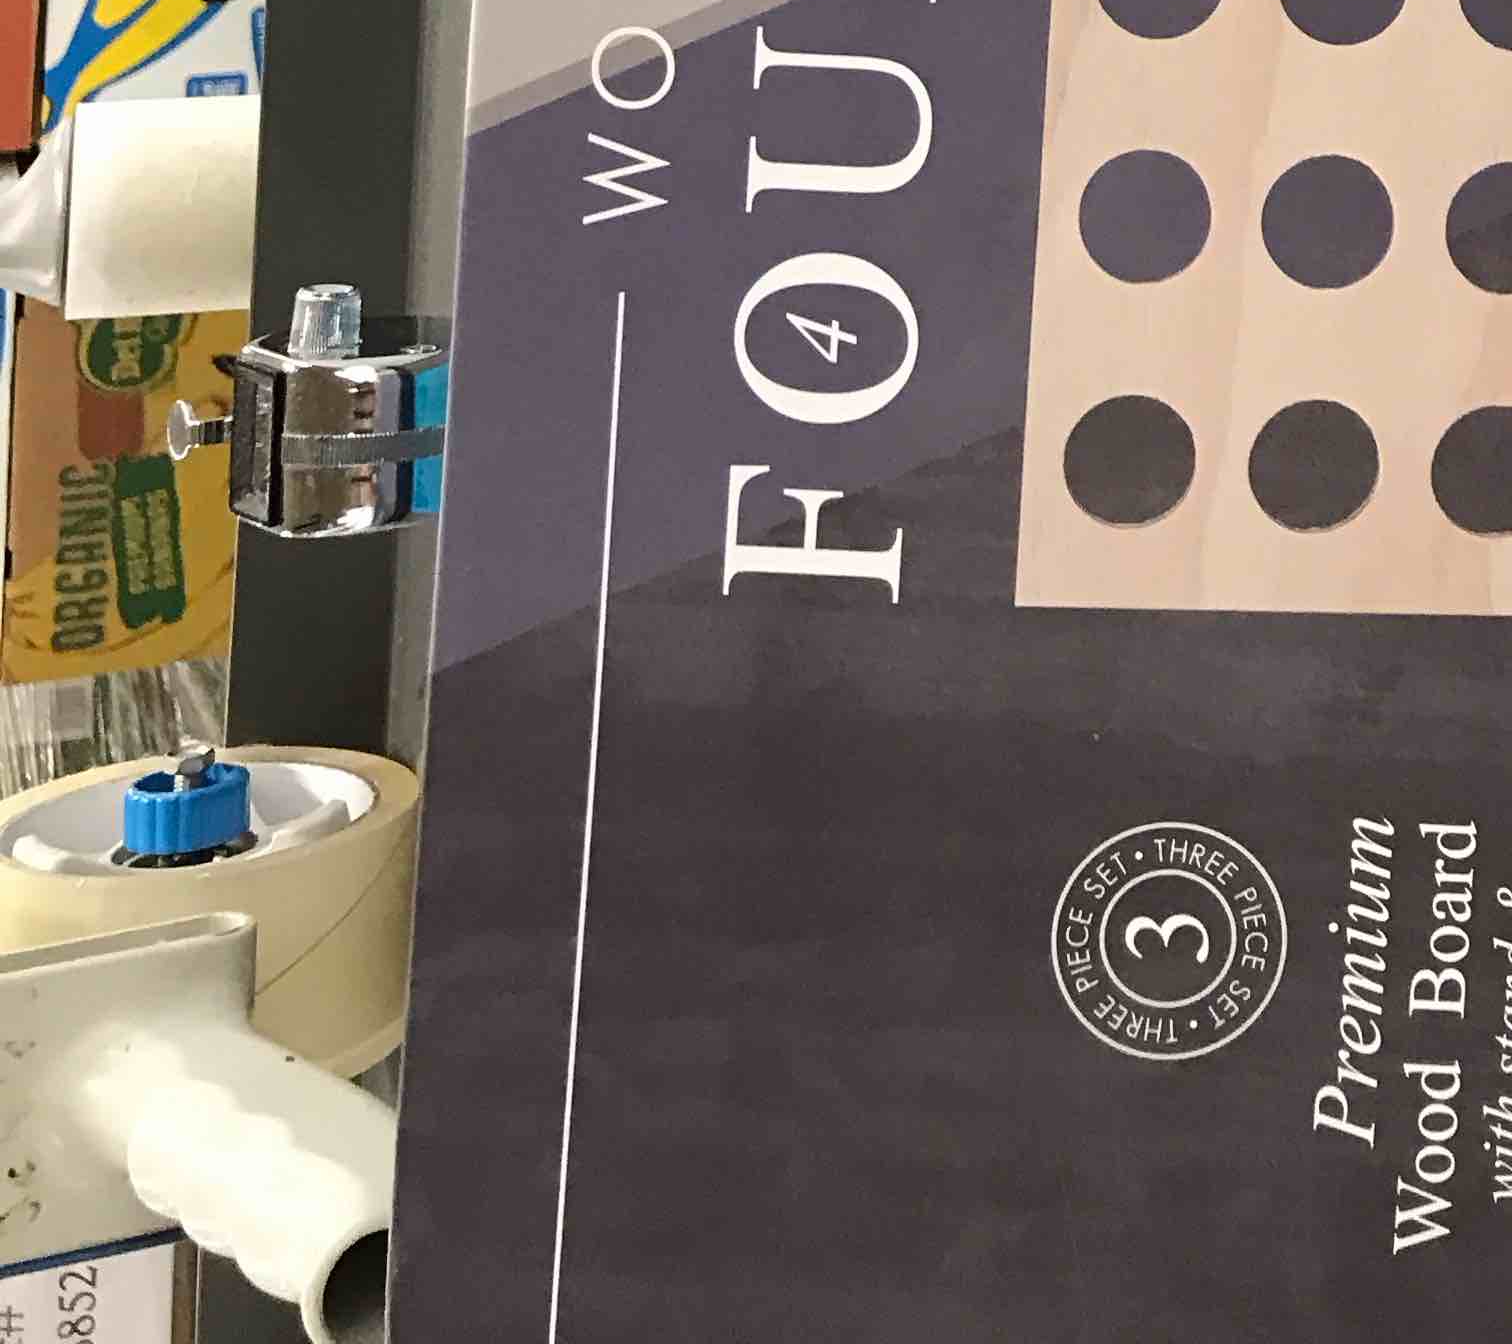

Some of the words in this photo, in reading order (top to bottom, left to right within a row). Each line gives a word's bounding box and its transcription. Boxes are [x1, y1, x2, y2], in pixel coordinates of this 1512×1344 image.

[785, 311, 857, 363] 4
[50, 462, 113, 652] ORGANIC
[1083, 850, 1127, 899] SET
[1153, 837, 1240, 884] THREE
[1065, 905, 1099, 992] PIECE
[1124, 911, 1210, 963] 3
[1233, 885, 1269, 971] PIECE
[1407, 819, 1478, 1018] Board
[1092, 993, 1178, 1043] THREE
[1207, 978, 1251, 1029] SET
[1312, 814, 1396, 1149] Premium
[1392, 1058, 1461, 1254] Wood
[57, 1265, 97, 1343] 852
